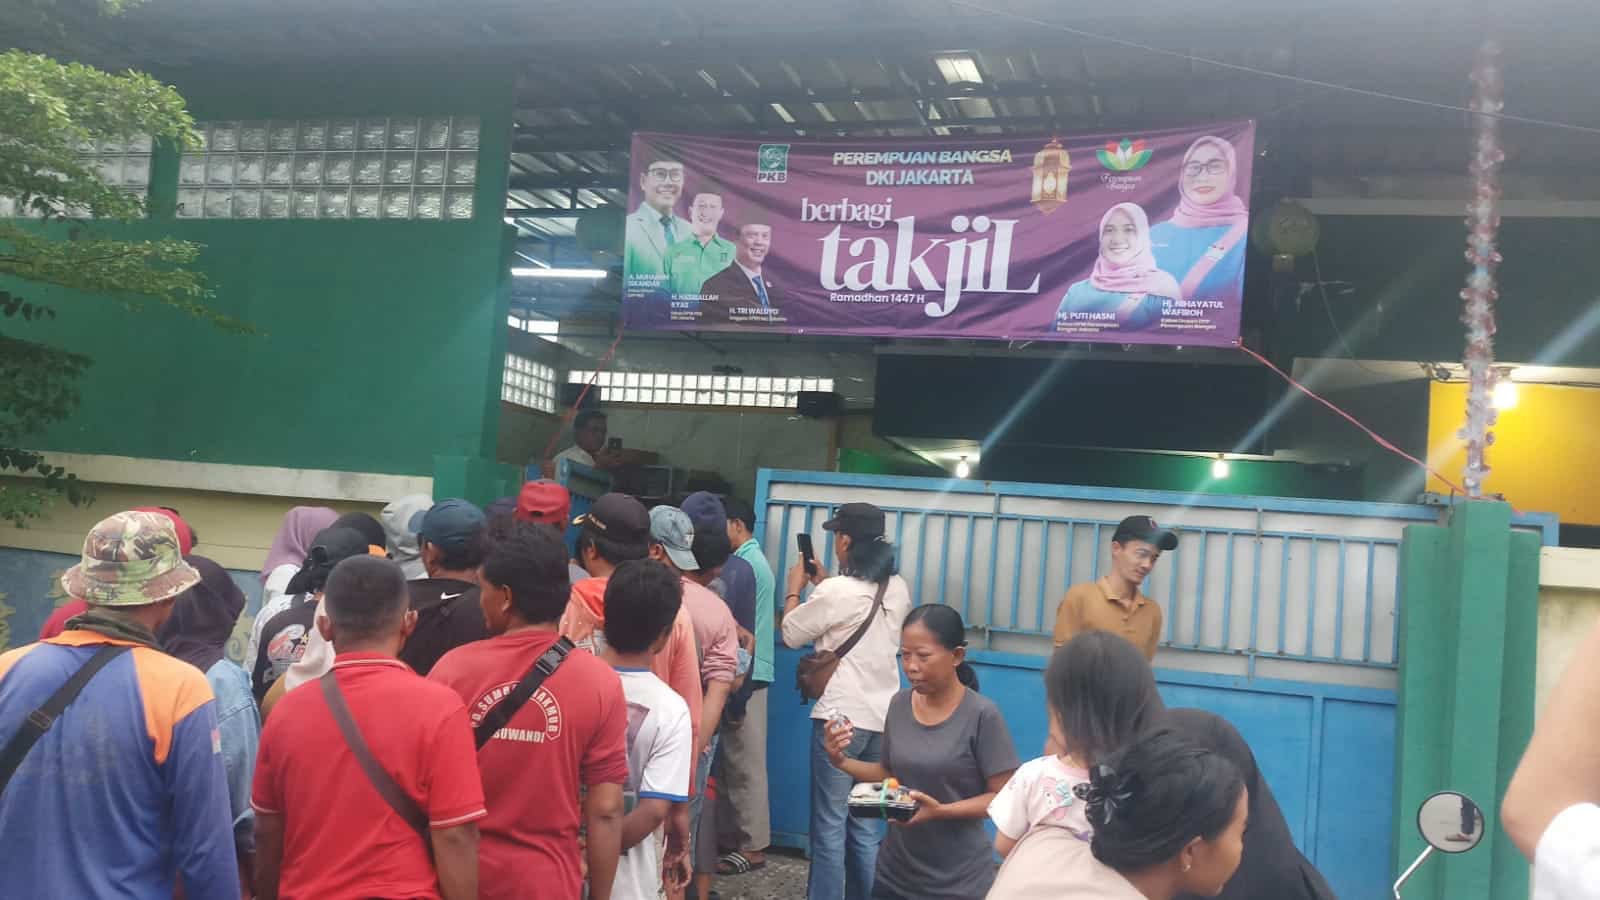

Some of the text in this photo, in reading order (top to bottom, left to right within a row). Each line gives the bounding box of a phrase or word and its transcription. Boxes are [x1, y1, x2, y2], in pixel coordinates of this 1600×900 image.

[833, 149, 1012, 165] PEREMPUAN BANGSA
[758, 171, 785, 181] PKB
[866, 169, 974, 186] DKI JAKARTA
[801, 197, 892, 229] berbagi
[830, 292, 925, 304] Ramadhan 1447 H
[1070, 312, 1088, 320] PUTI
[1089, 312, 1116, 320] HASNI
